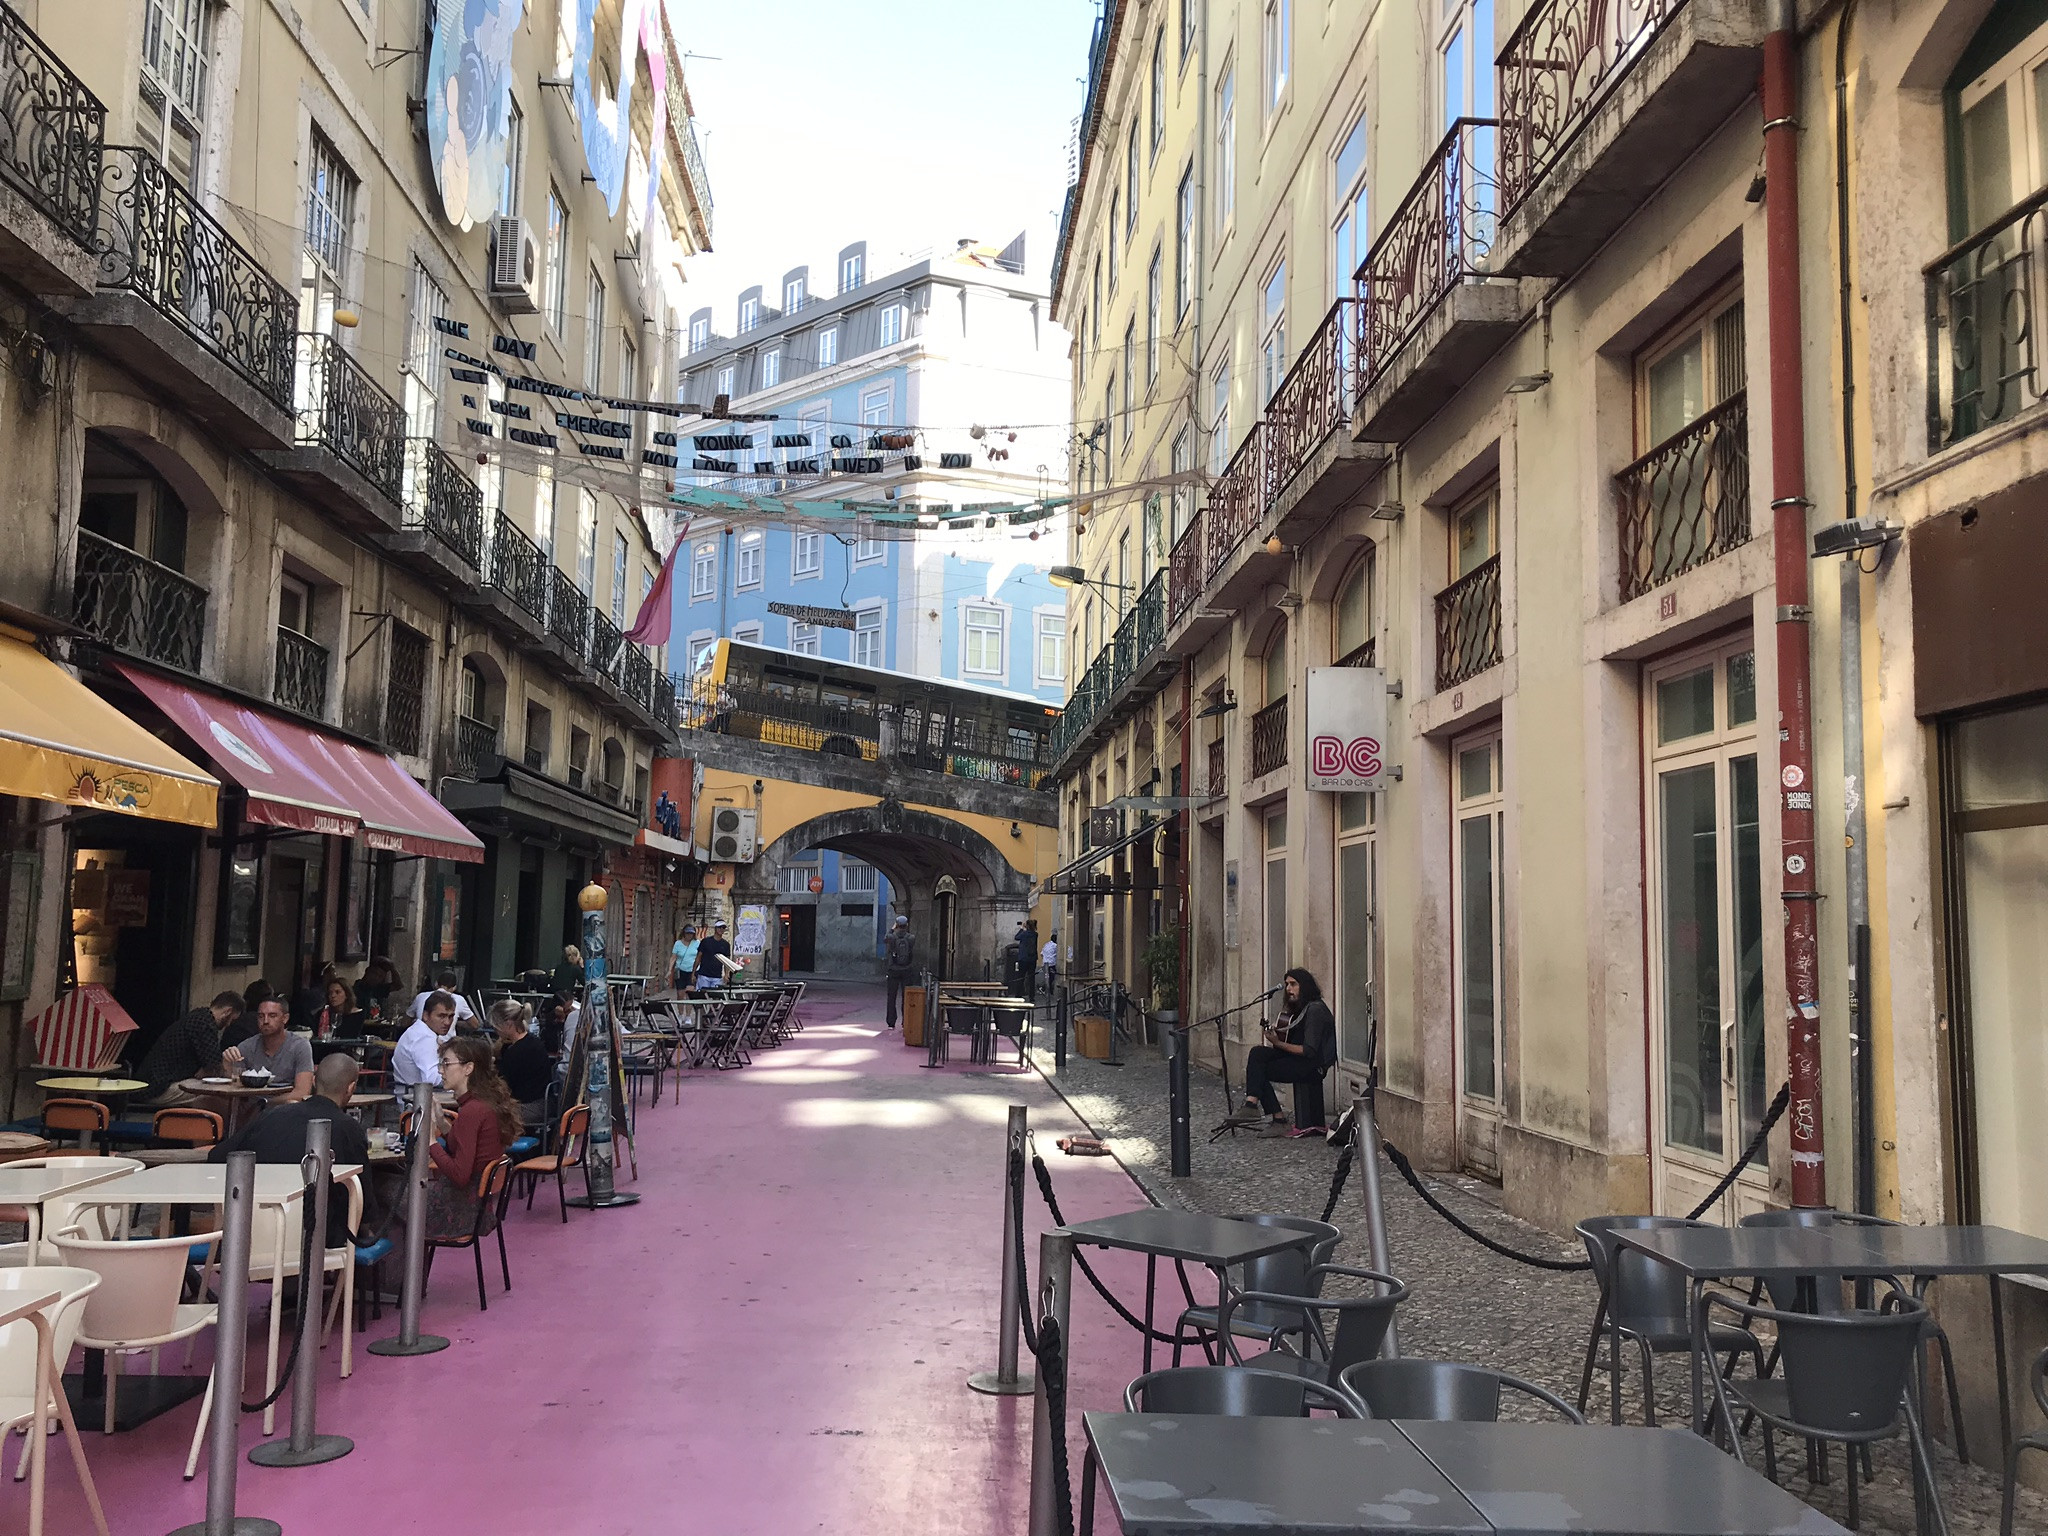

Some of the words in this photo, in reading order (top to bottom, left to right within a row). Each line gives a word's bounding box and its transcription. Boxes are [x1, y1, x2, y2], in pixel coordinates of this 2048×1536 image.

[434, 316, 468, 340] THE
[494, 334, 534, 361] DAY
[461, 393, 475, 409] A
[490, 399, 530, 420] POEM
[556, 412, 631, 438] EMERGES
[653, 431, 677, 447] SO
[694, 434, 752, 450] YOUNG
[772, 434, 811, 447] AND
[829, 433, 851, 448] SO
[467, 418, 493, 436] YOU
[509, 427, 557, 448] CAN'T
[579, 443, 624, 460] KNOW
[643, 449, 678, 468] HOW
[693, 458, 738, 473] LONG
[753, 461, 774, 474] IT
[787, 459, 819, 474] HAS
[831, 458, 883, 473] LIVED
[904, 455, 921, 471] IN
[940, 453, 971, 468] YOU
[768, 601, 795, 615] SOPHIA
[796, 604, 806, 617] DE
[1663, 595, 1673, 616] 51
[806, 617, 855, 629] ANDRESEN
[1313, 736, 1382, 777] BC
[113, 778, 149, 795] PESCA
[1321, 778, 1339, 786] BAR
[1354, 779, 1373, 787] CAIS
[1786, 791, 1811, 800] MONDE
